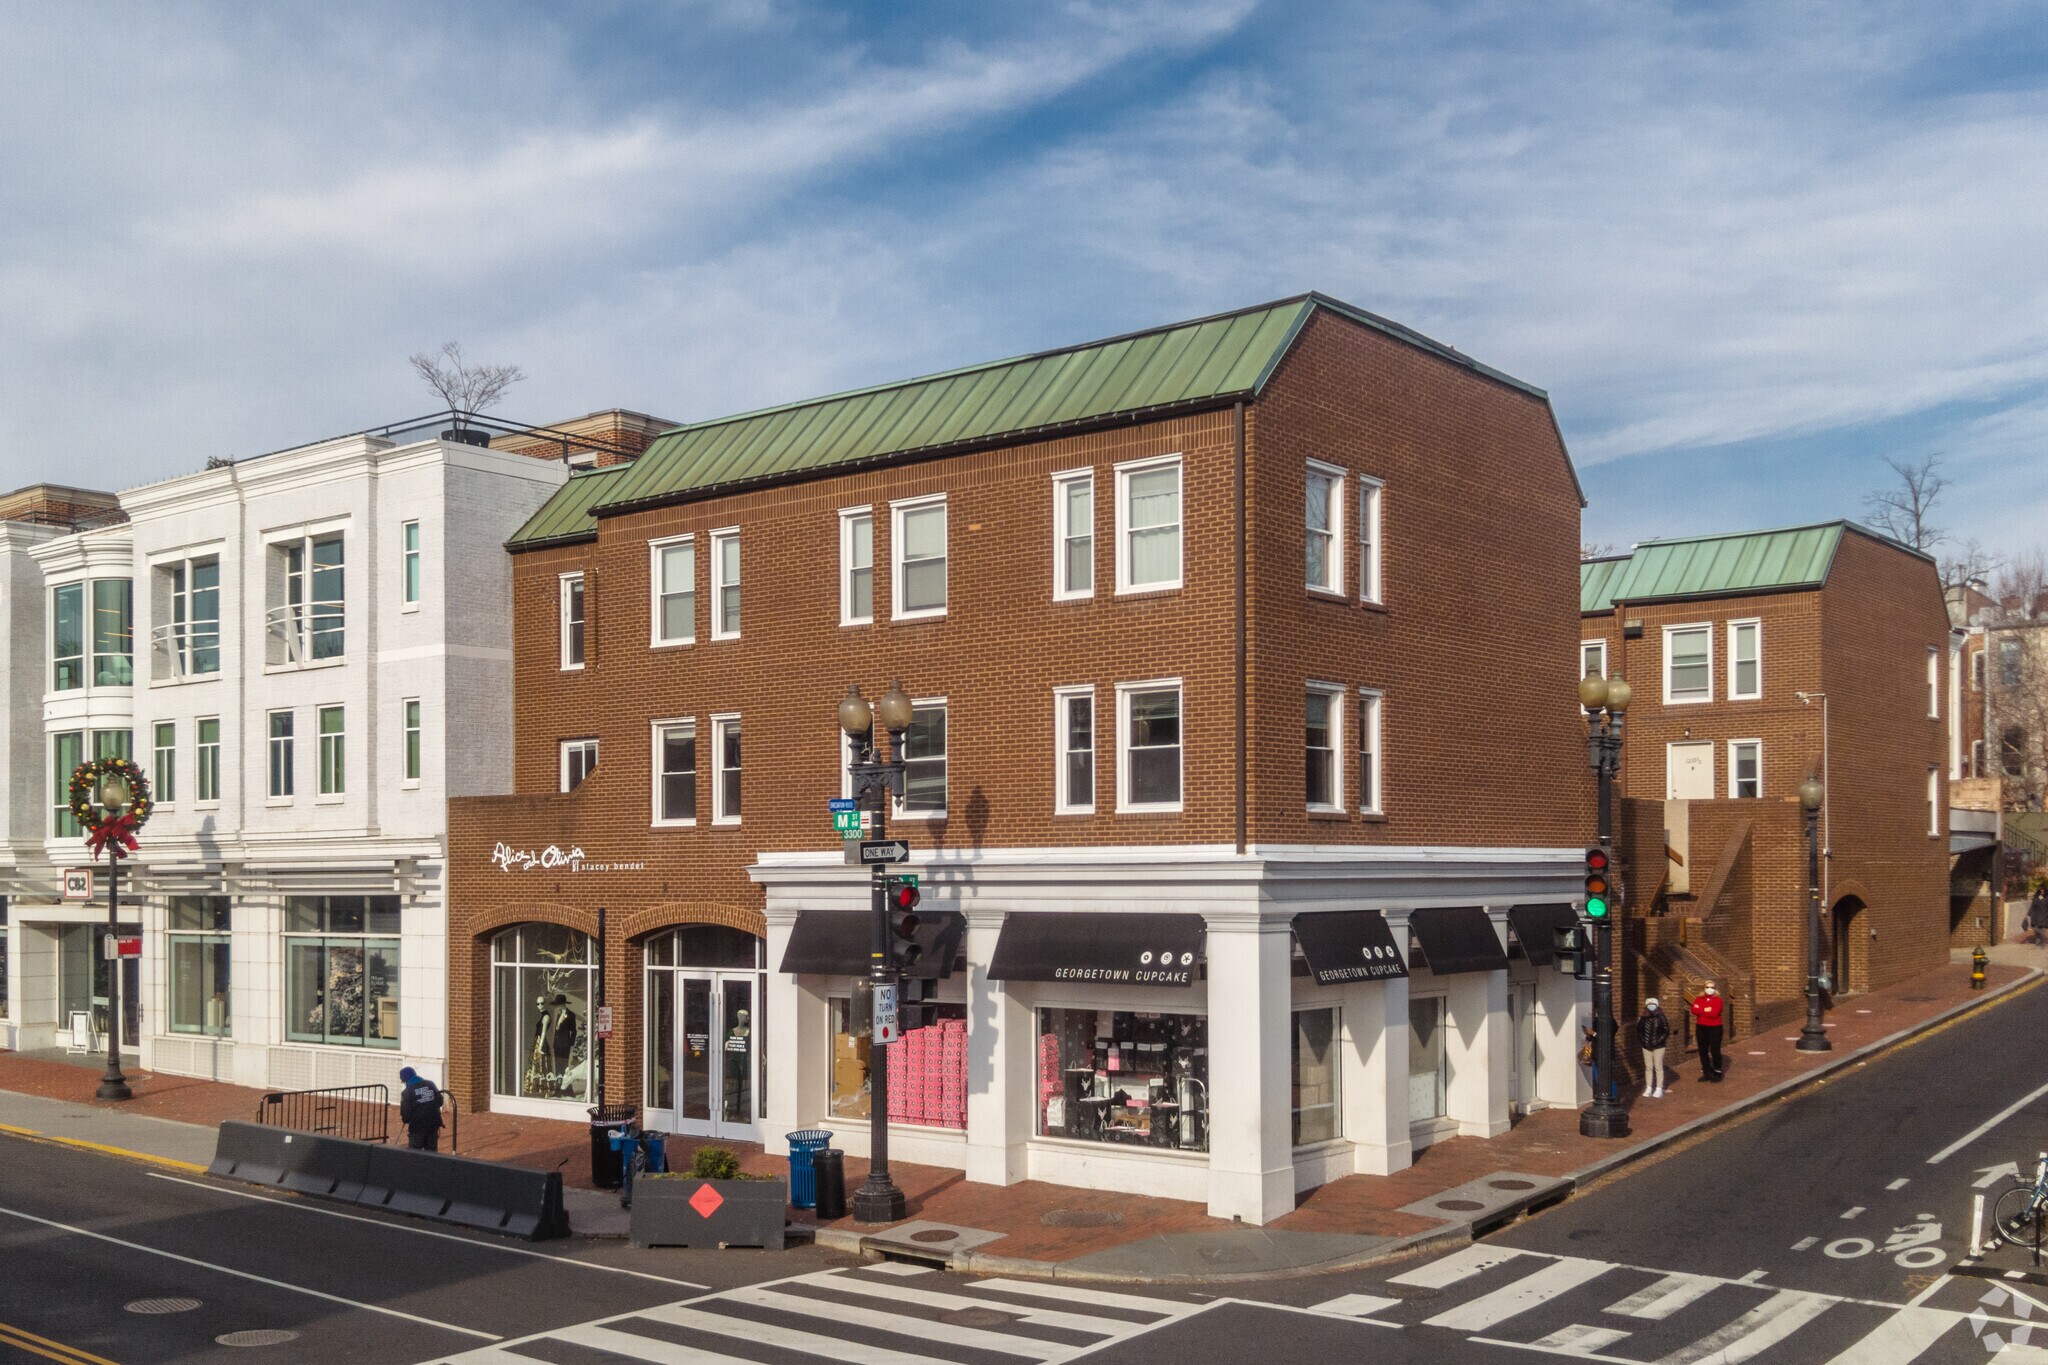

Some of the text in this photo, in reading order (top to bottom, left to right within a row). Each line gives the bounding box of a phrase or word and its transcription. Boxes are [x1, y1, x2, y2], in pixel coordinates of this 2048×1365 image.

[837, 814, 848, 828] M
[843, 830, 862, 839] 3300
[491, 842, 530, 872] Alice
[541, 844, 585, 868] Olivia
[864, 847, 895, 858] ONE WAY
[581, 863, 609, 872] stacey
[67, 876, 87, 891] CB2
[1055, 968, 1188, 983] GEORGETOWN CUPCAKE
[1319, 963, 1402, 981] GEORGETOWN CUPCAKE
[880, 989, 891, 1000] NO
[879, 1003, 893, 1012] TURN
[875, 1014, 895, 1025] ON RED
